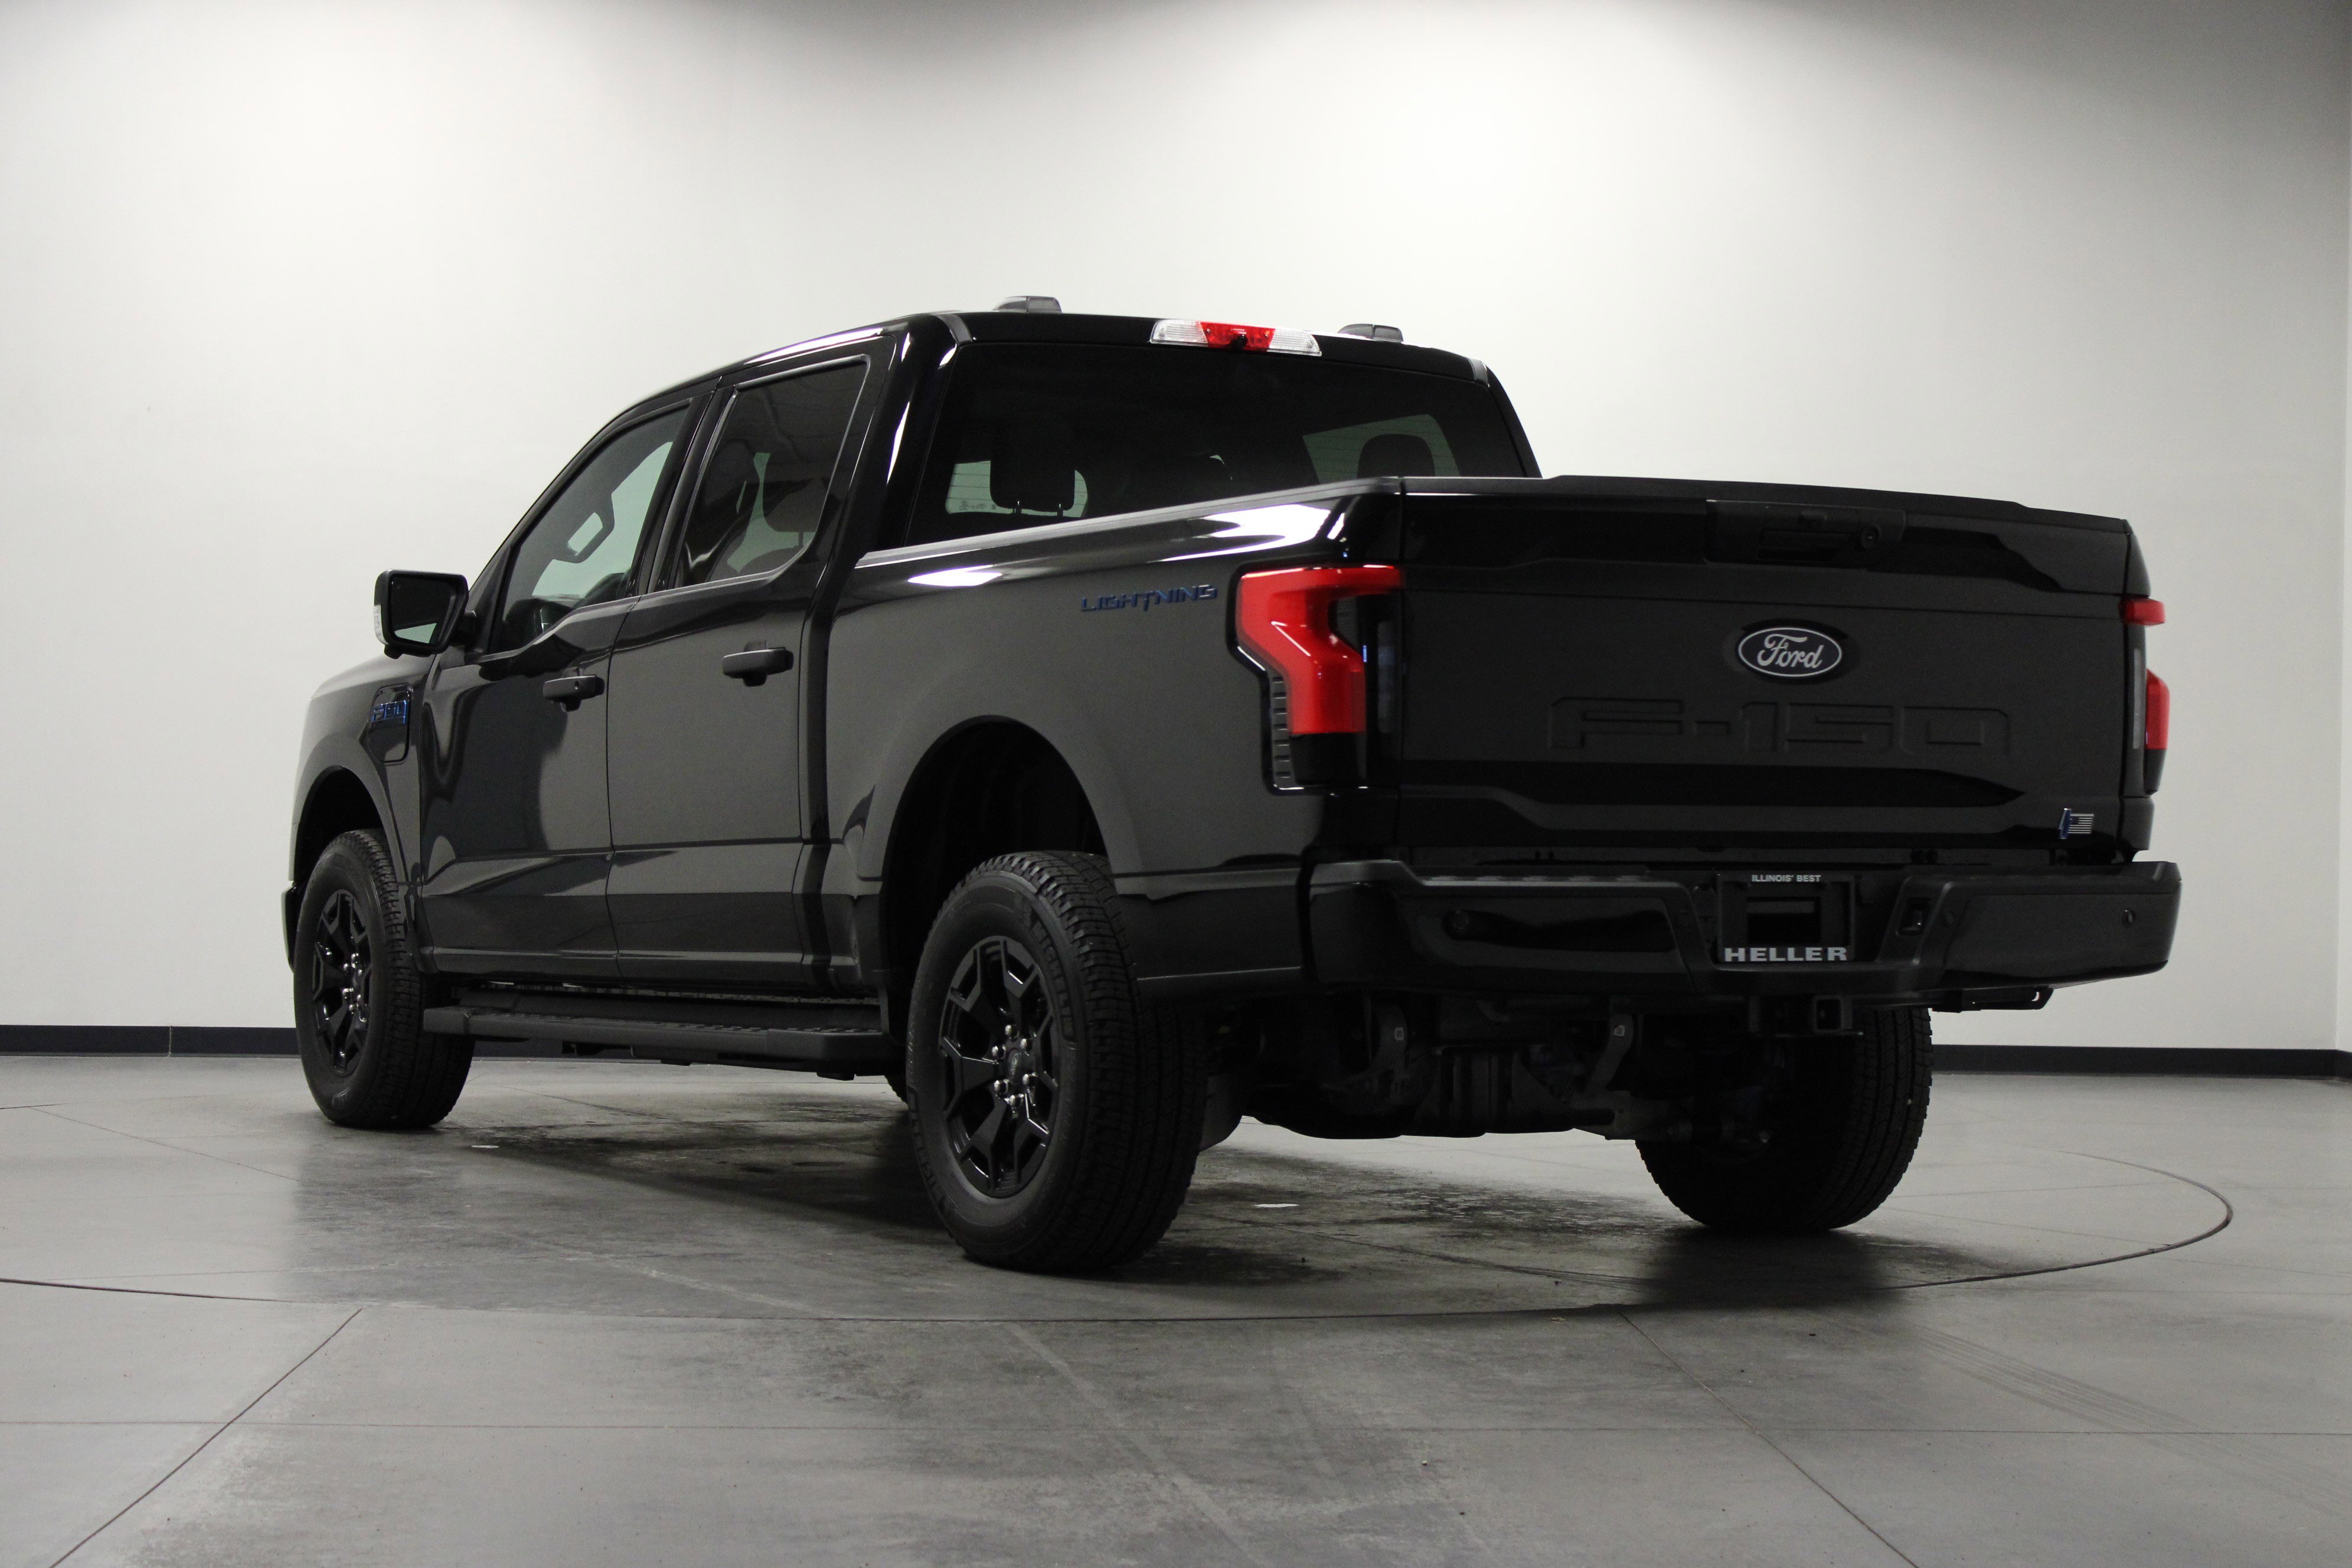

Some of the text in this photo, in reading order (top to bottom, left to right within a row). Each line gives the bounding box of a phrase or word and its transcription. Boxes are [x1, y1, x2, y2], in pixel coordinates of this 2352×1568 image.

[1081, 584, 1217, 612] LIGHTNING
[1757, 633, 1825, 669] Ford
[1547, 697, 2008, 756] F-150
[1796, 874, 1821, 883] BEST
[1724, 946, 1848, 962] HELLER
